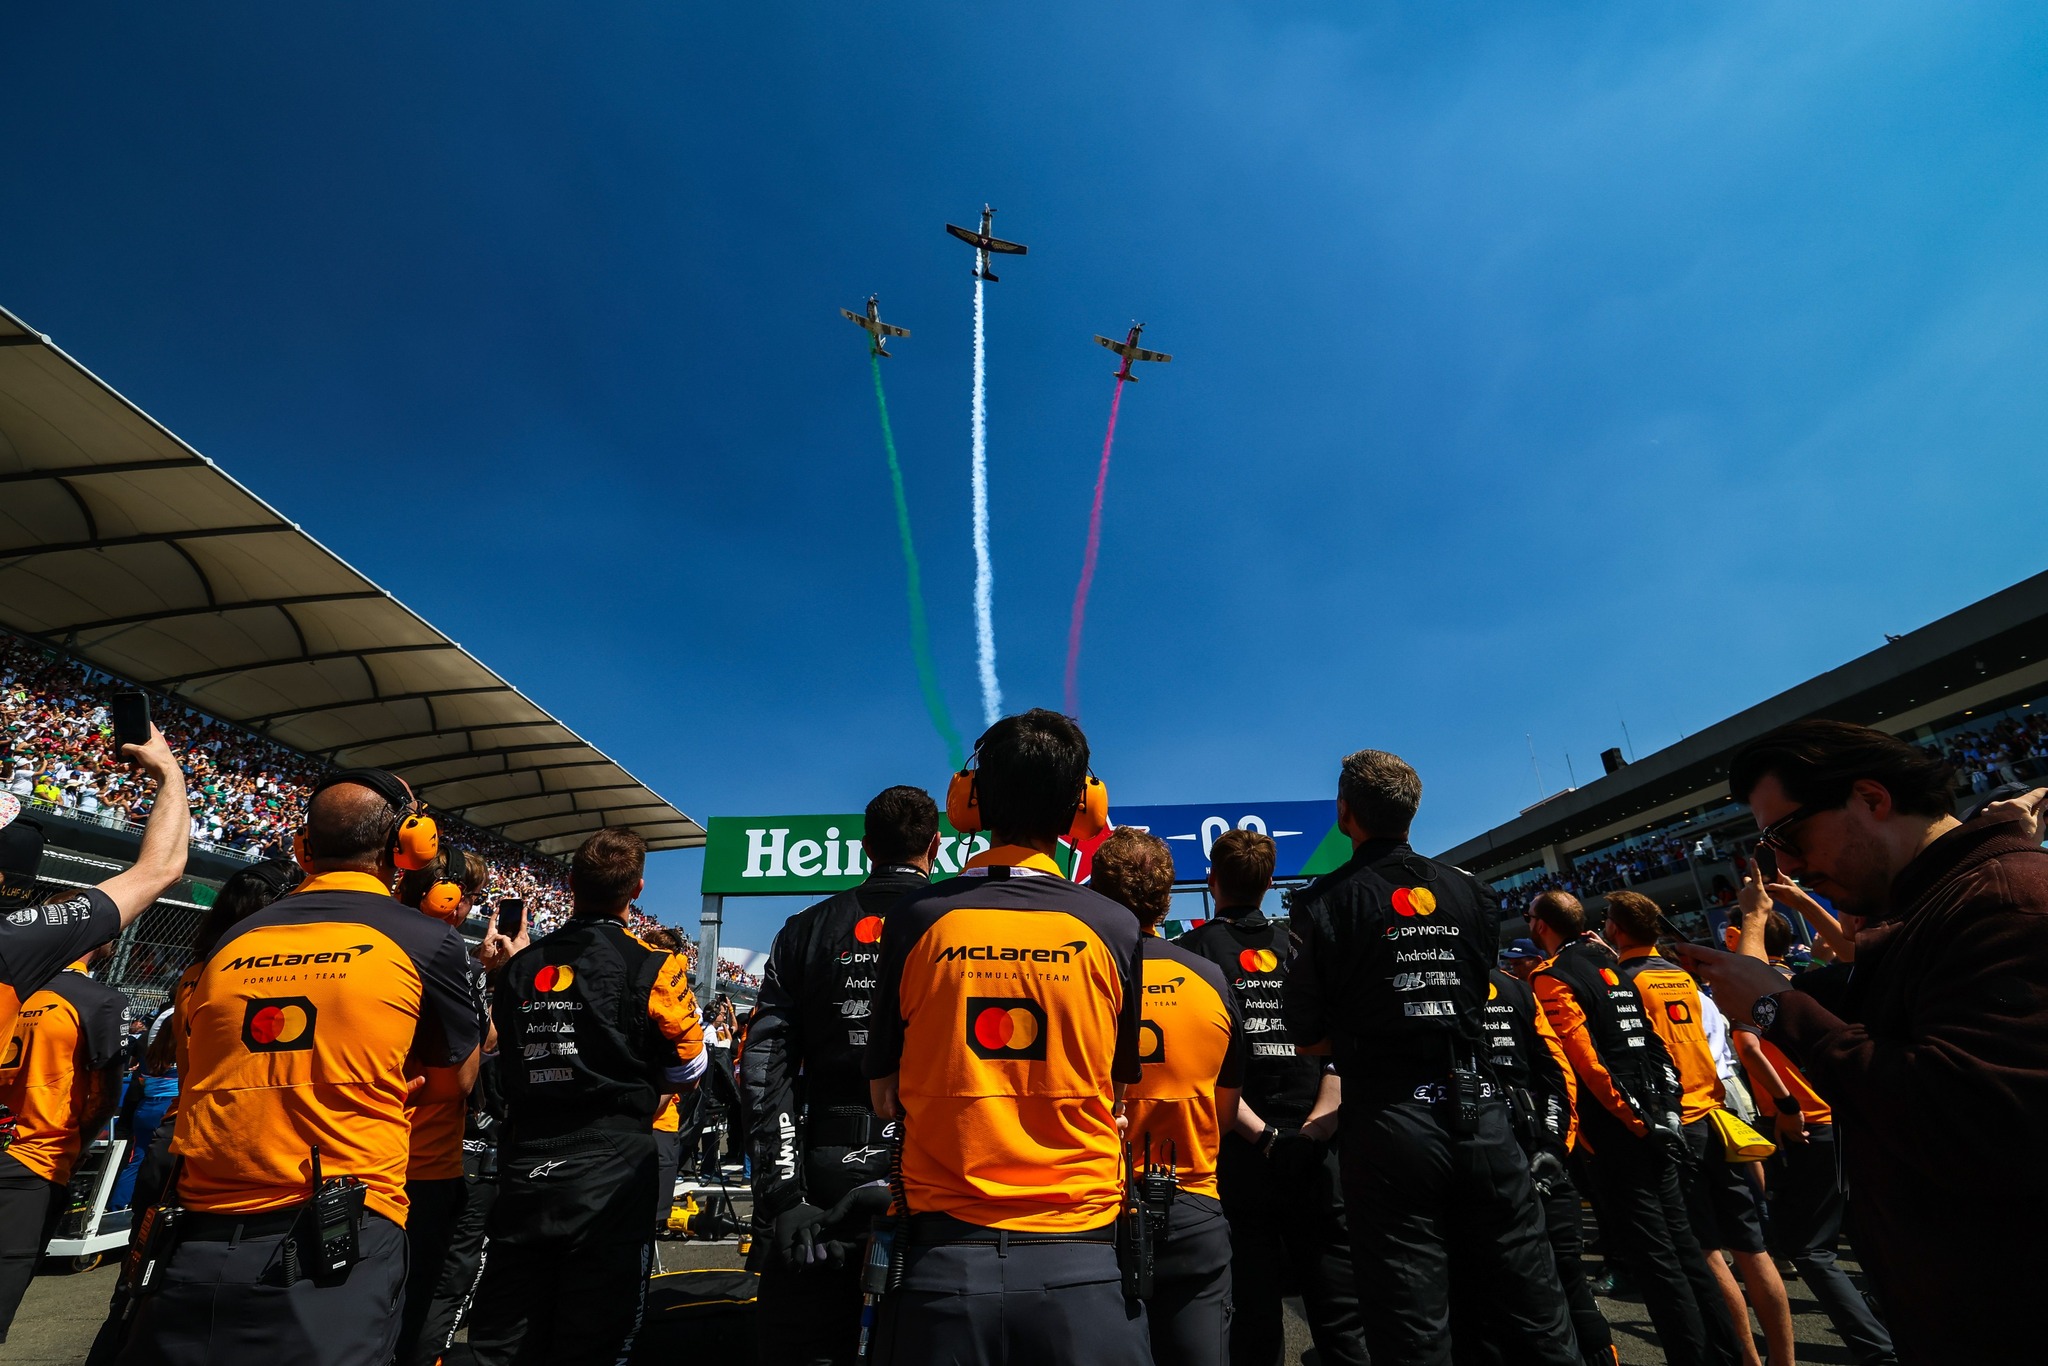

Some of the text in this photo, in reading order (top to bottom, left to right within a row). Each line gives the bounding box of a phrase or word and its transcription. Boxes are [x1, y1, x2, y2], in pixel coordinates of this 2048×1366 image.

[742, 827, 991, 877] Heinke
[1401, 926, 1460, 936] DP WORLD
[854, 953, 871, 963] DP
[935, 945, 1070, 963] McLaren
[1396, 948, 1437, 962] Android
[220, 950, 352, 972] McLaren
[243, 974, 296, 985] FORMULA
[960, 971, 1018, 980] FORMULA
[1038, 973, 1070, 982] TEAM
[1425, 971, 1456, 979] OPTIMUM
[845, 976, 876, 988] Andro
[1247, 980, 1283, 988] DP WOR
[534, 1001, 583, 1010] DP WORLD
[1245, 998, 1278, 1009] Android
[526, 1022, 559, 1033] Android
[775, 1112, 796, 1180] allwyn
